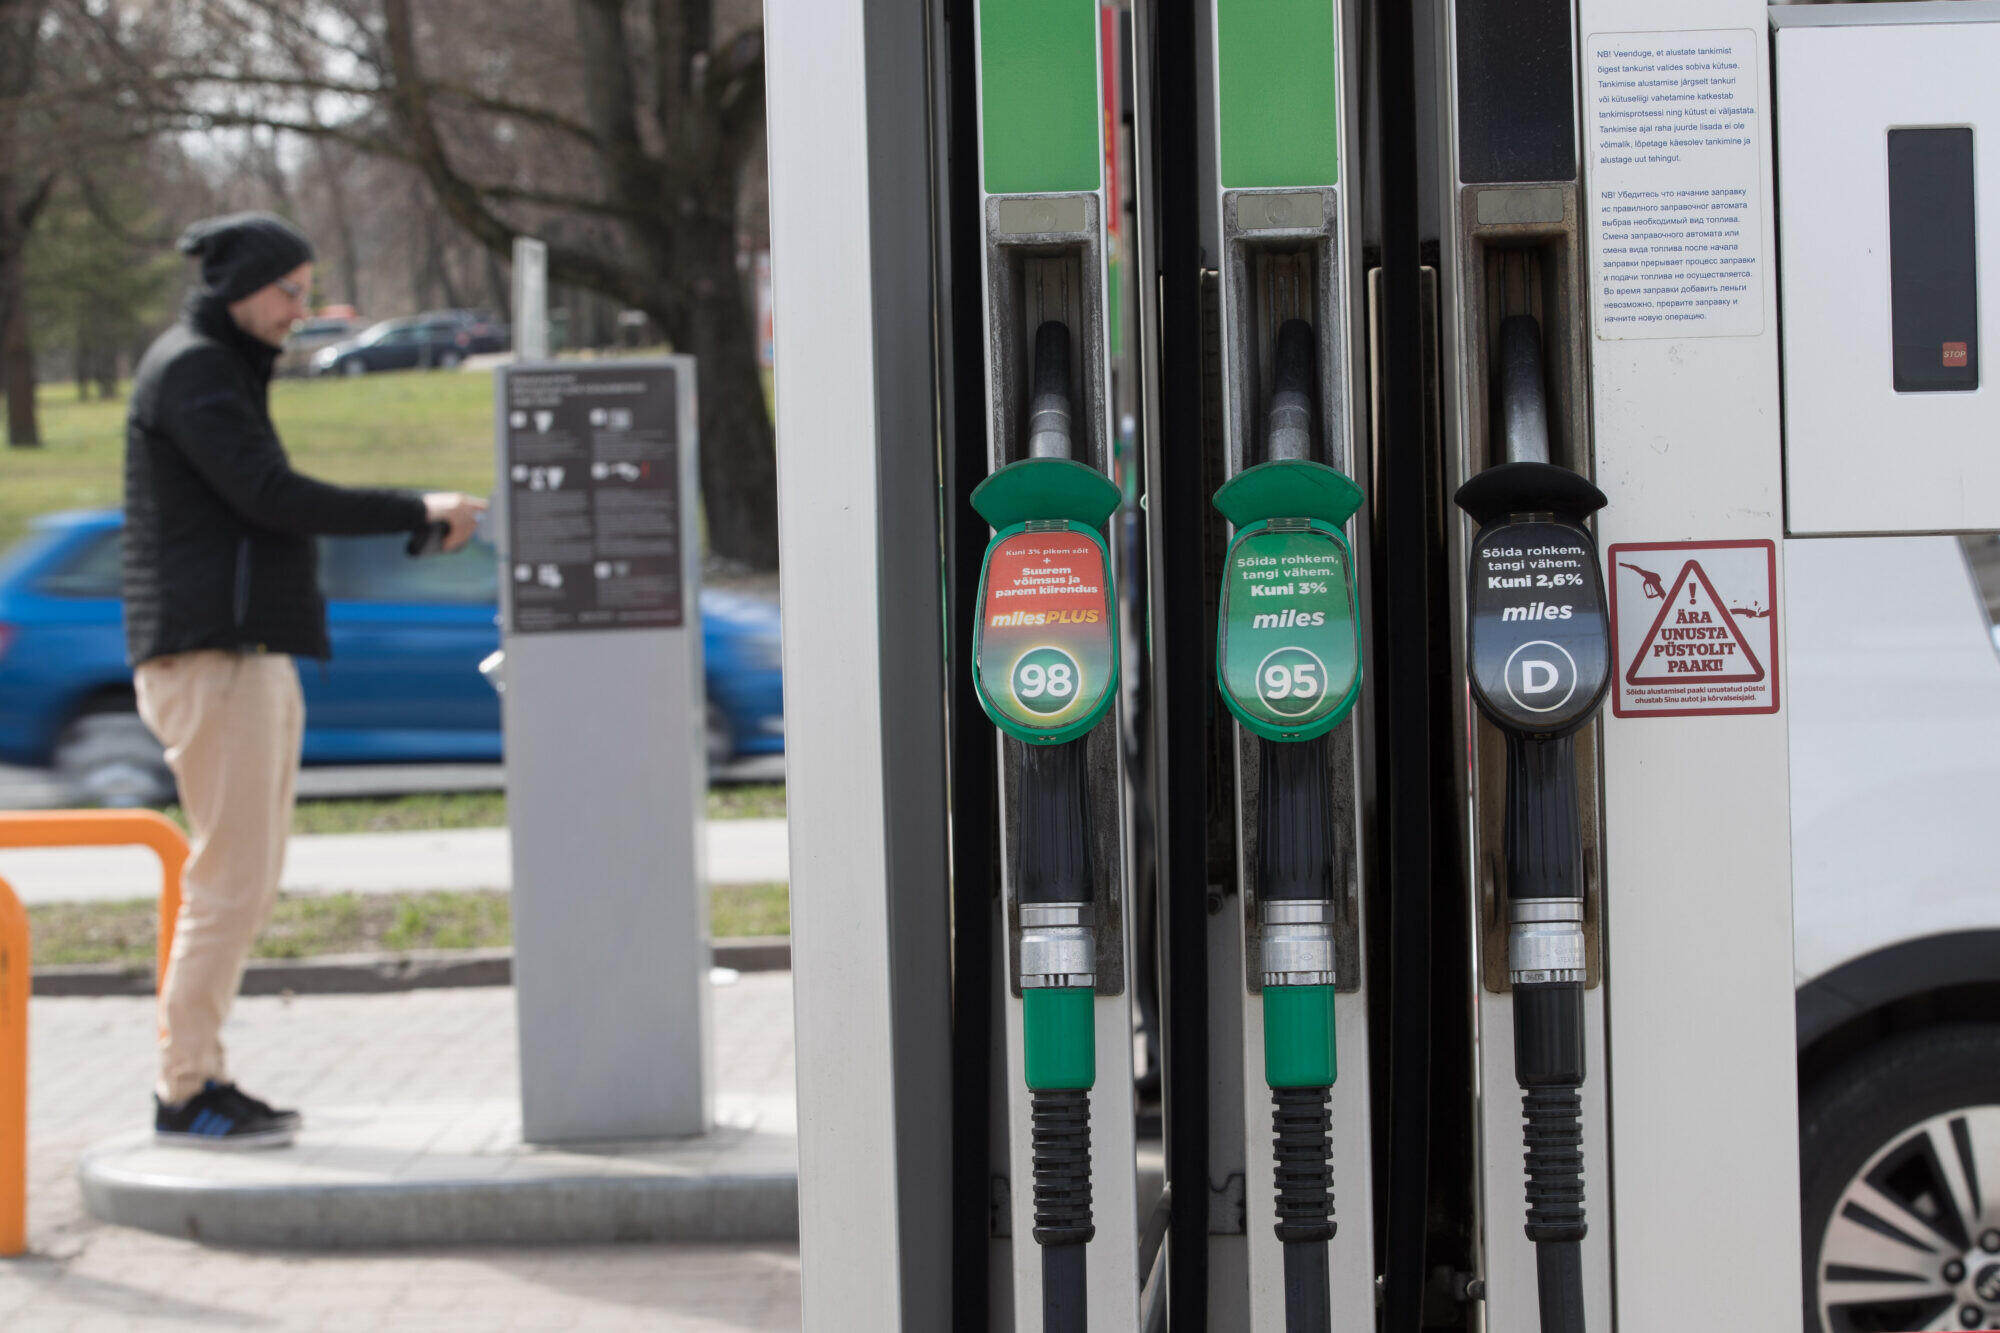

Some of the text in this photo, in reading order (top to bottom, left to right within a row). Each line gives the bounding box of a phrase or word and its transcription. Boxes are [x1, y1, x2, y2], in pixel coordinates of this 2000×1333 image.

[1666, 48, 1696, 56] alustate
[1686, 63, 1711, 71] sobiva
[1598, 80, 1636, 88] Tankimise
[1680, 78, 1709, 87] järgselt
[1611, 95, 1649, 104] kütuseliigi
[1651, 93, 1695, 102] vahetamine
[1697, 92, 1734, 100] katkestab
[1599, 109, 1664, 118] tankimisprotsessi
[1666, 109, 1683, 118] ning
[1684, 108, 1708, 116] kütust
[1639, 125, 1653, 134] ajal
[1674, 124, 1698, 133] juurde
[1700, 123, 1723, 131] lisada
[1733, 122, 1745, 130] ole
[1635, 140, 1668, 149] lõpetage
[1670, 138, 1704, 147] käesolev
[1705, 138, 1742, 146] tankimine
[1744, 138, 1751, 146] ja
[1600, 156, 1632, 165] alustage
[1648, 155, 1680, 164] tehingut.
[1006, 549, 1026, 557] Kuni
[1042, 548, 1070, 556] pikem
[1482, 546, 1585, 558] Sõida rohkem,
[1237, 555, 1339, 568] Sõida rohkem,
[1488, 559, 1581, 571] tangi vähem.
[1022, 568, 1072, 576] Suurem
[1242, 567, 1334, 580] tangi vähem.
[1014, 576, 1080, 585] võimsus ja
[1488, 574, 1583, 589] Kuni 2,6%
[995, 585, 1098, 598] parem kiirendus
[1251, 582, 1327, 597] Kuni 3%
[991, 610, 1100, 626] milesPLUS
[1502, 602, 1573, 622] miles
[1676, 609, 1712, 624] ÄRA
[1253, 609, 1325, 629] miles
[1661, 627, 1728, 640] UNUSTA
[1654, 642, 1736, 657] PÜSTOLIT
[1667, 659, 1723, 673] PAAKI!
[1020, 664, 1072, 698] 98
[1265, 664, 1318, 699] 95
[1522, 660, 1559, 693] D
[1625, 688, 1646, 696] Sõidu
[1687, 687, 1706, 695] paaki
[1743, 685, 1765, 693] püstol
